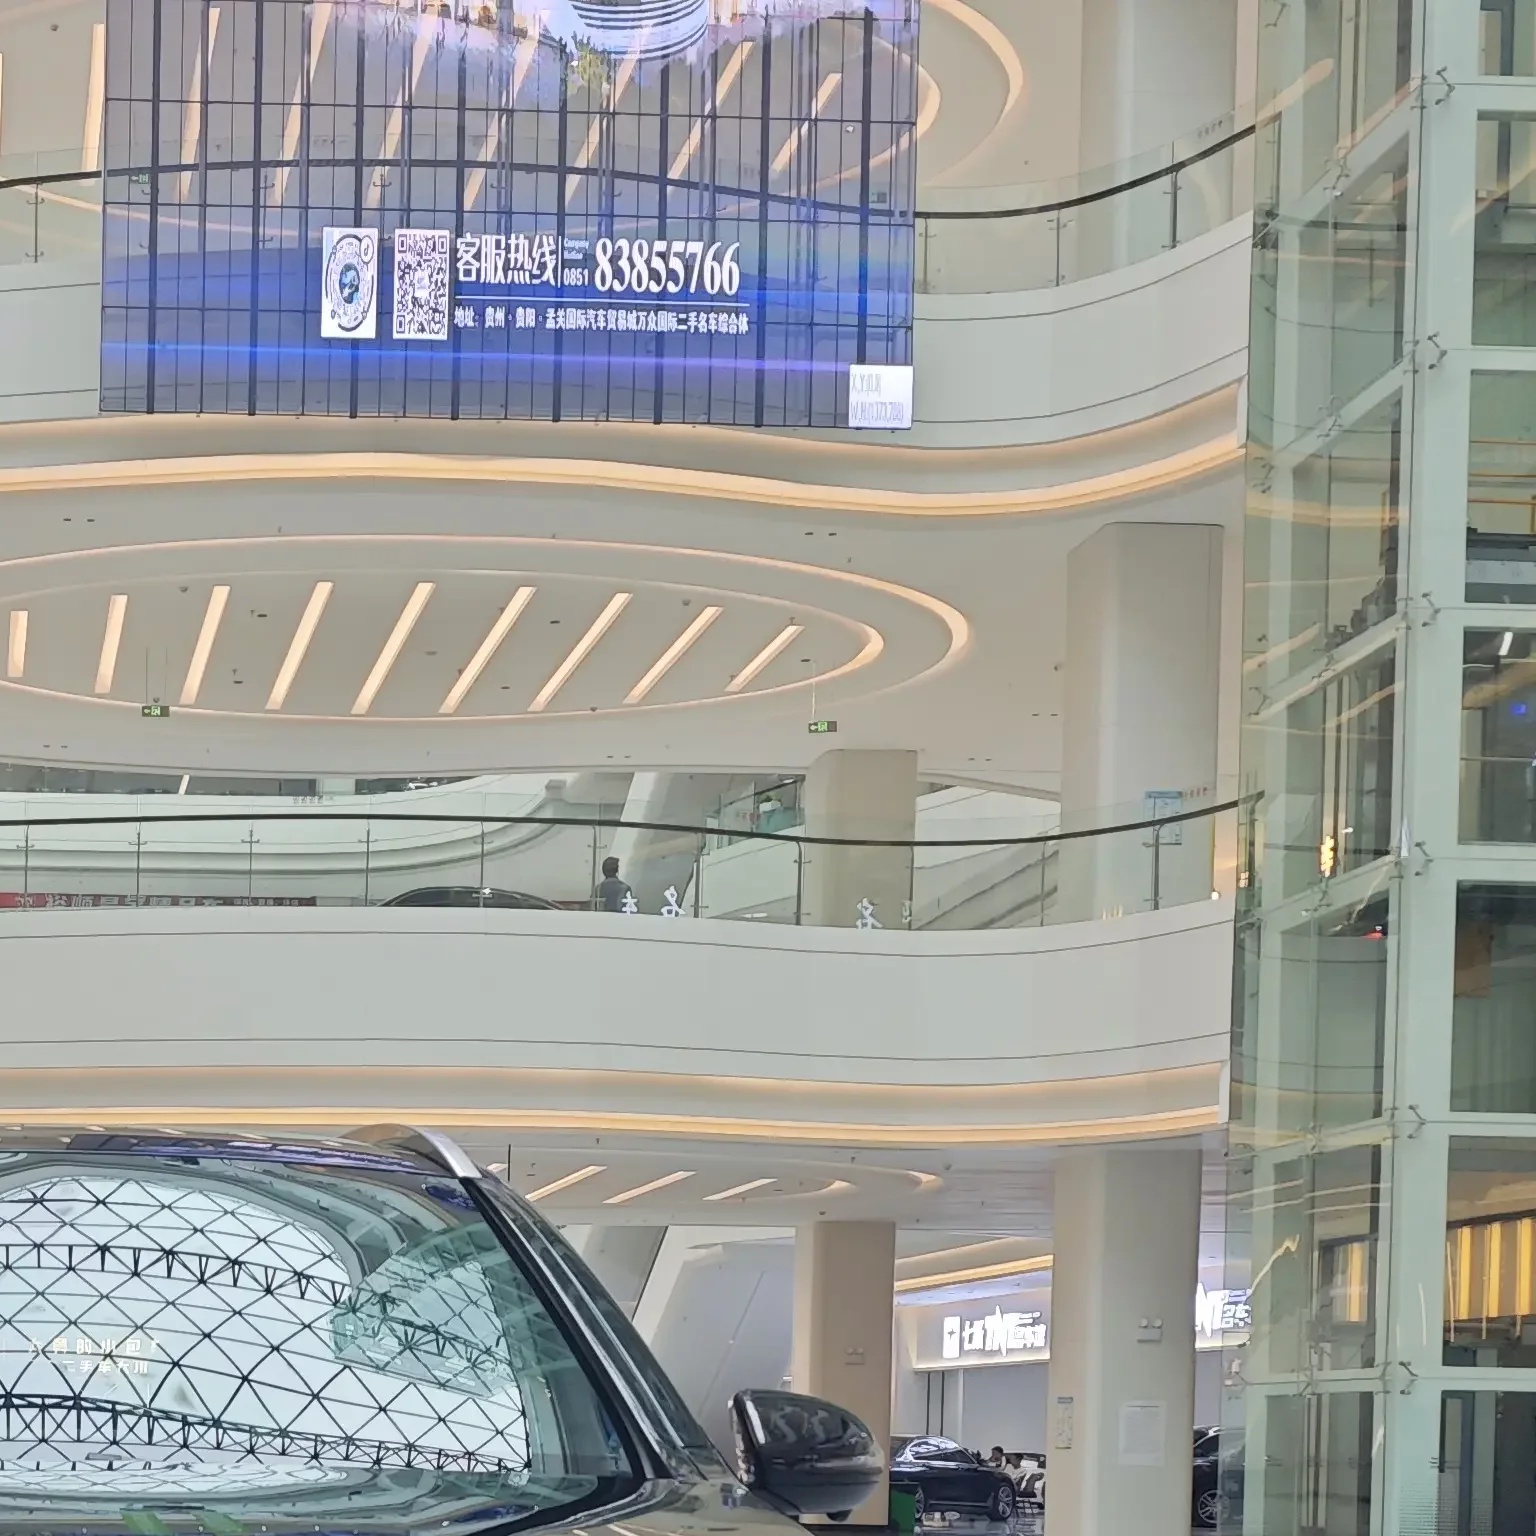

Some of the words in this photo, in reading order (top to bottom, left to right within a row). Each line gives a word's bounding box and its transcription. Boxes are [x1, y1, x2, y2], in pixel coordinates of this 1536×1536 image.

[456, 231, 556, 287] 客服热线
[563, 267, 589, 286] 0851
[594, 237, 740, 297] 83855766
